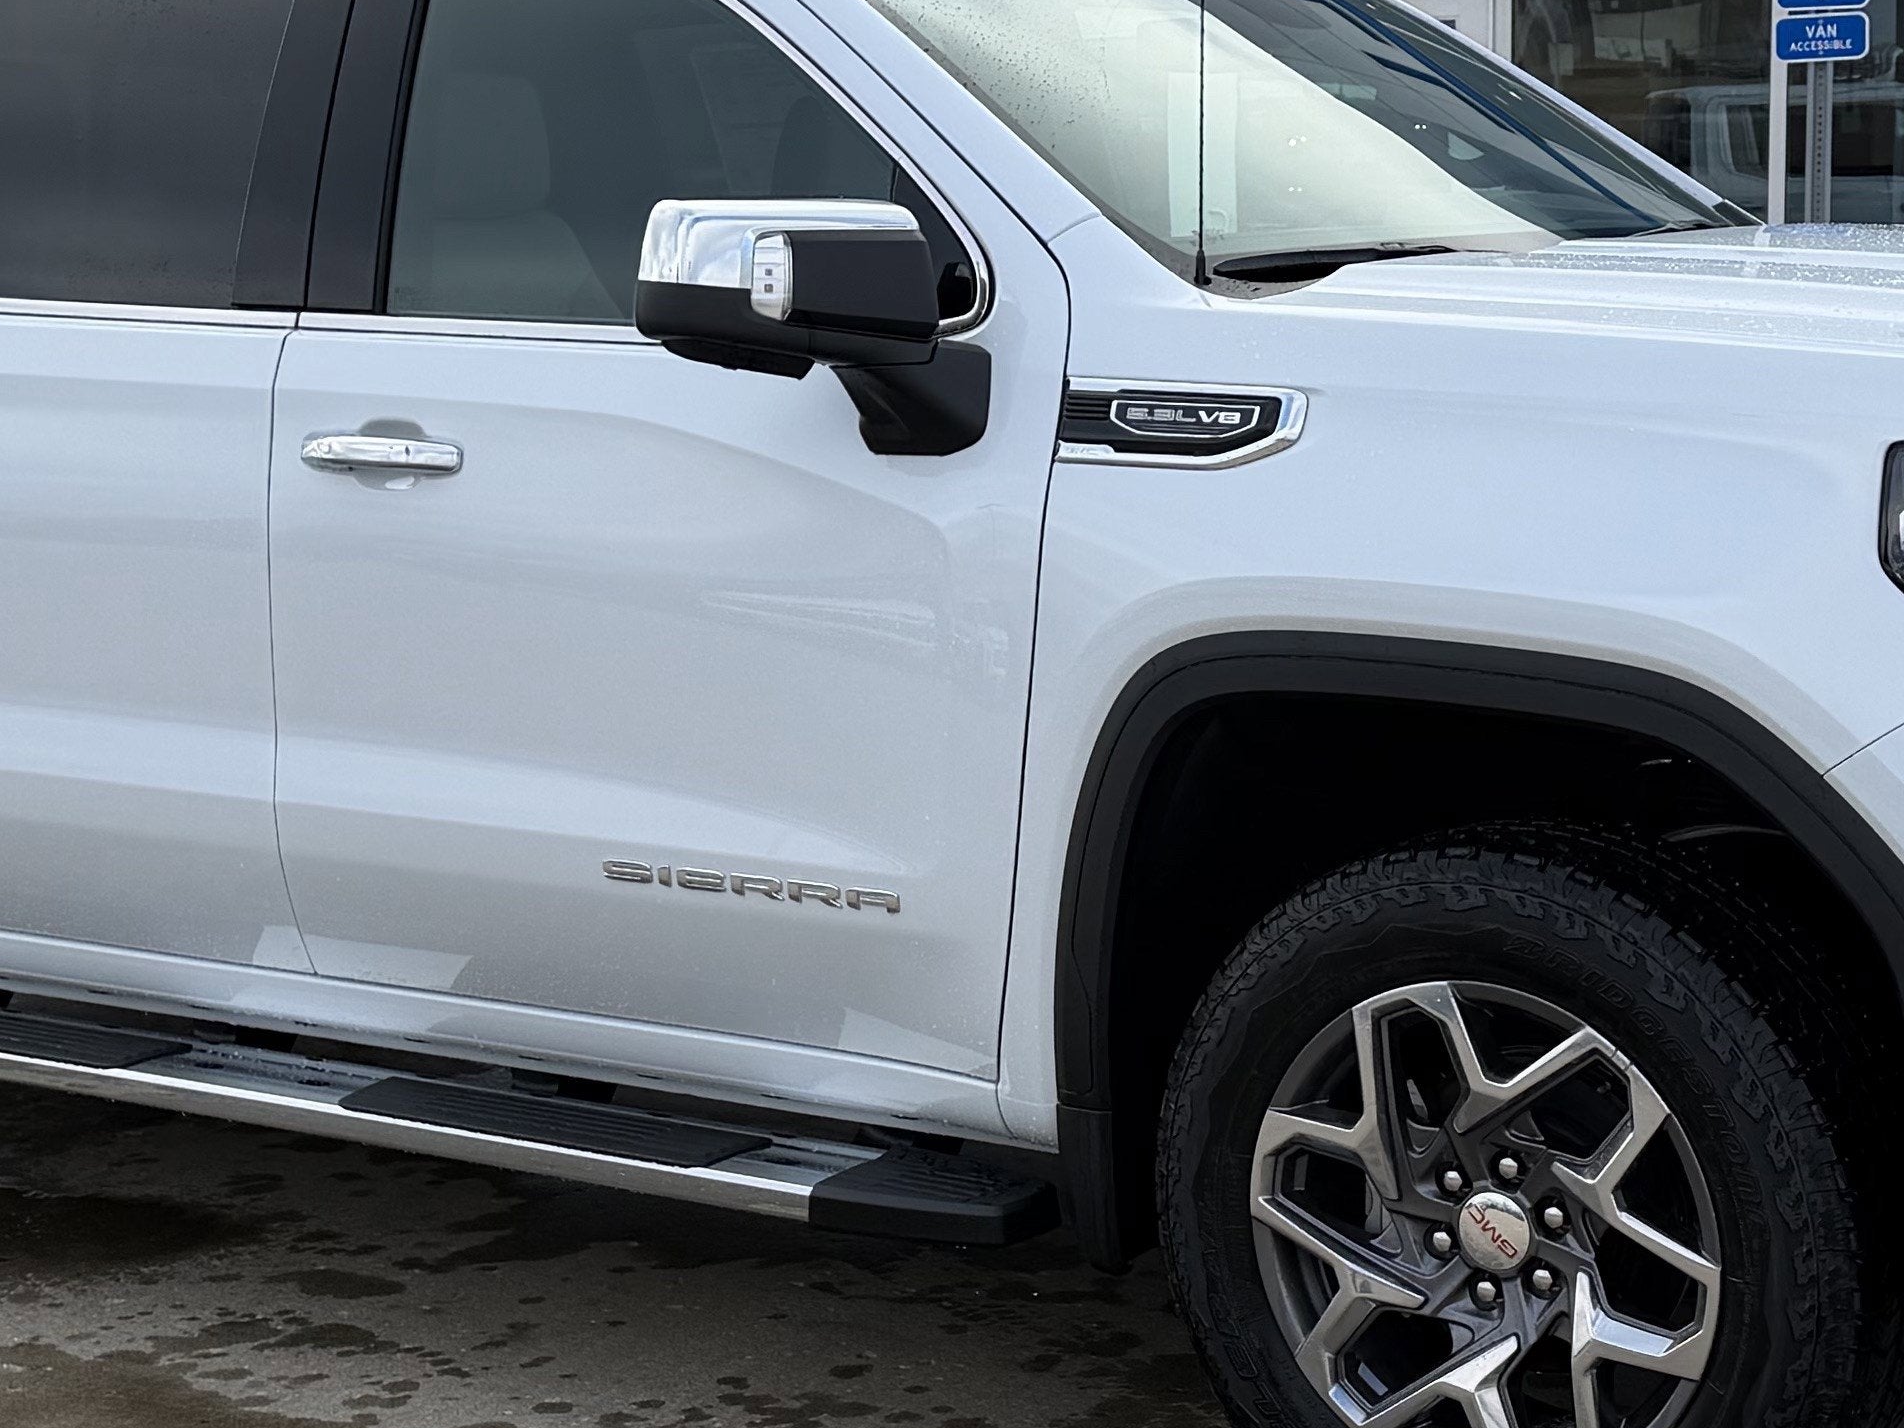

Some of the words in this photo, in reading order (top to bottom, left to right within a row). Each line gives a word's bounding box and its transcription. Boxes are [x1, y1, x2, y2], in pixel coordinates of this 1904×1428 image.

[1790, 39, 1853, 52] ACCESSIBLE
[1805, 23, 1838, 39] VAN
[602, 859, 901, 915] SIERRA
[1465, 1202, 1518, 1259] GMC
